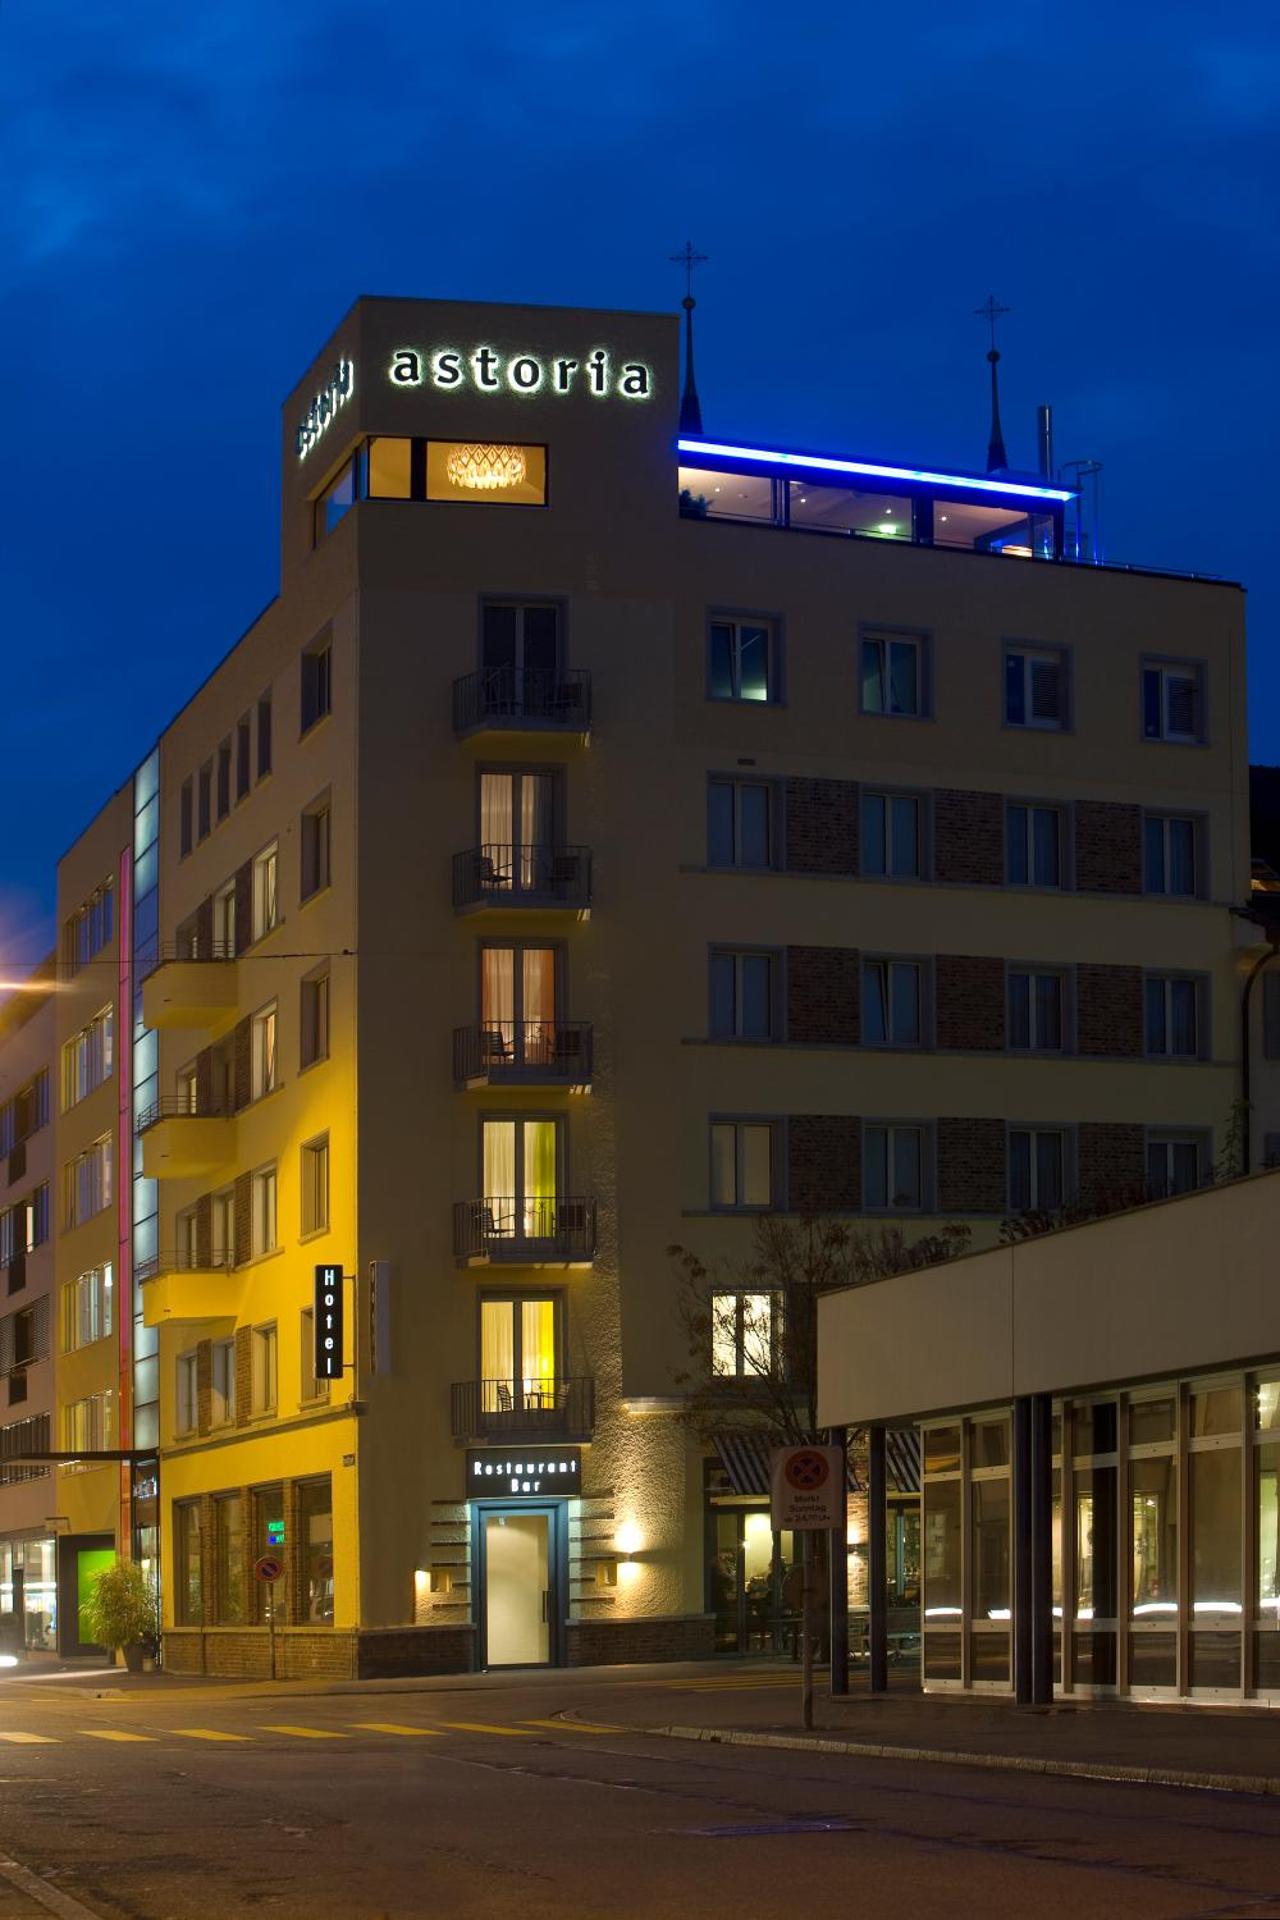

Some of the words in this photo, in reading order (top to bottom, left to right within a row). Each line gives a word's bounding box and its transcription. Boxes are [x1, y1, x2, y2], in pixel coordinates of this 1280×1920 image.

[391, 348, 650, 396] astoria
[323, 1268, 336, 1376] Hotel
[473, 1460, 577, 1476] Restaurant
[510, 1478, 541, 1493] Bar
